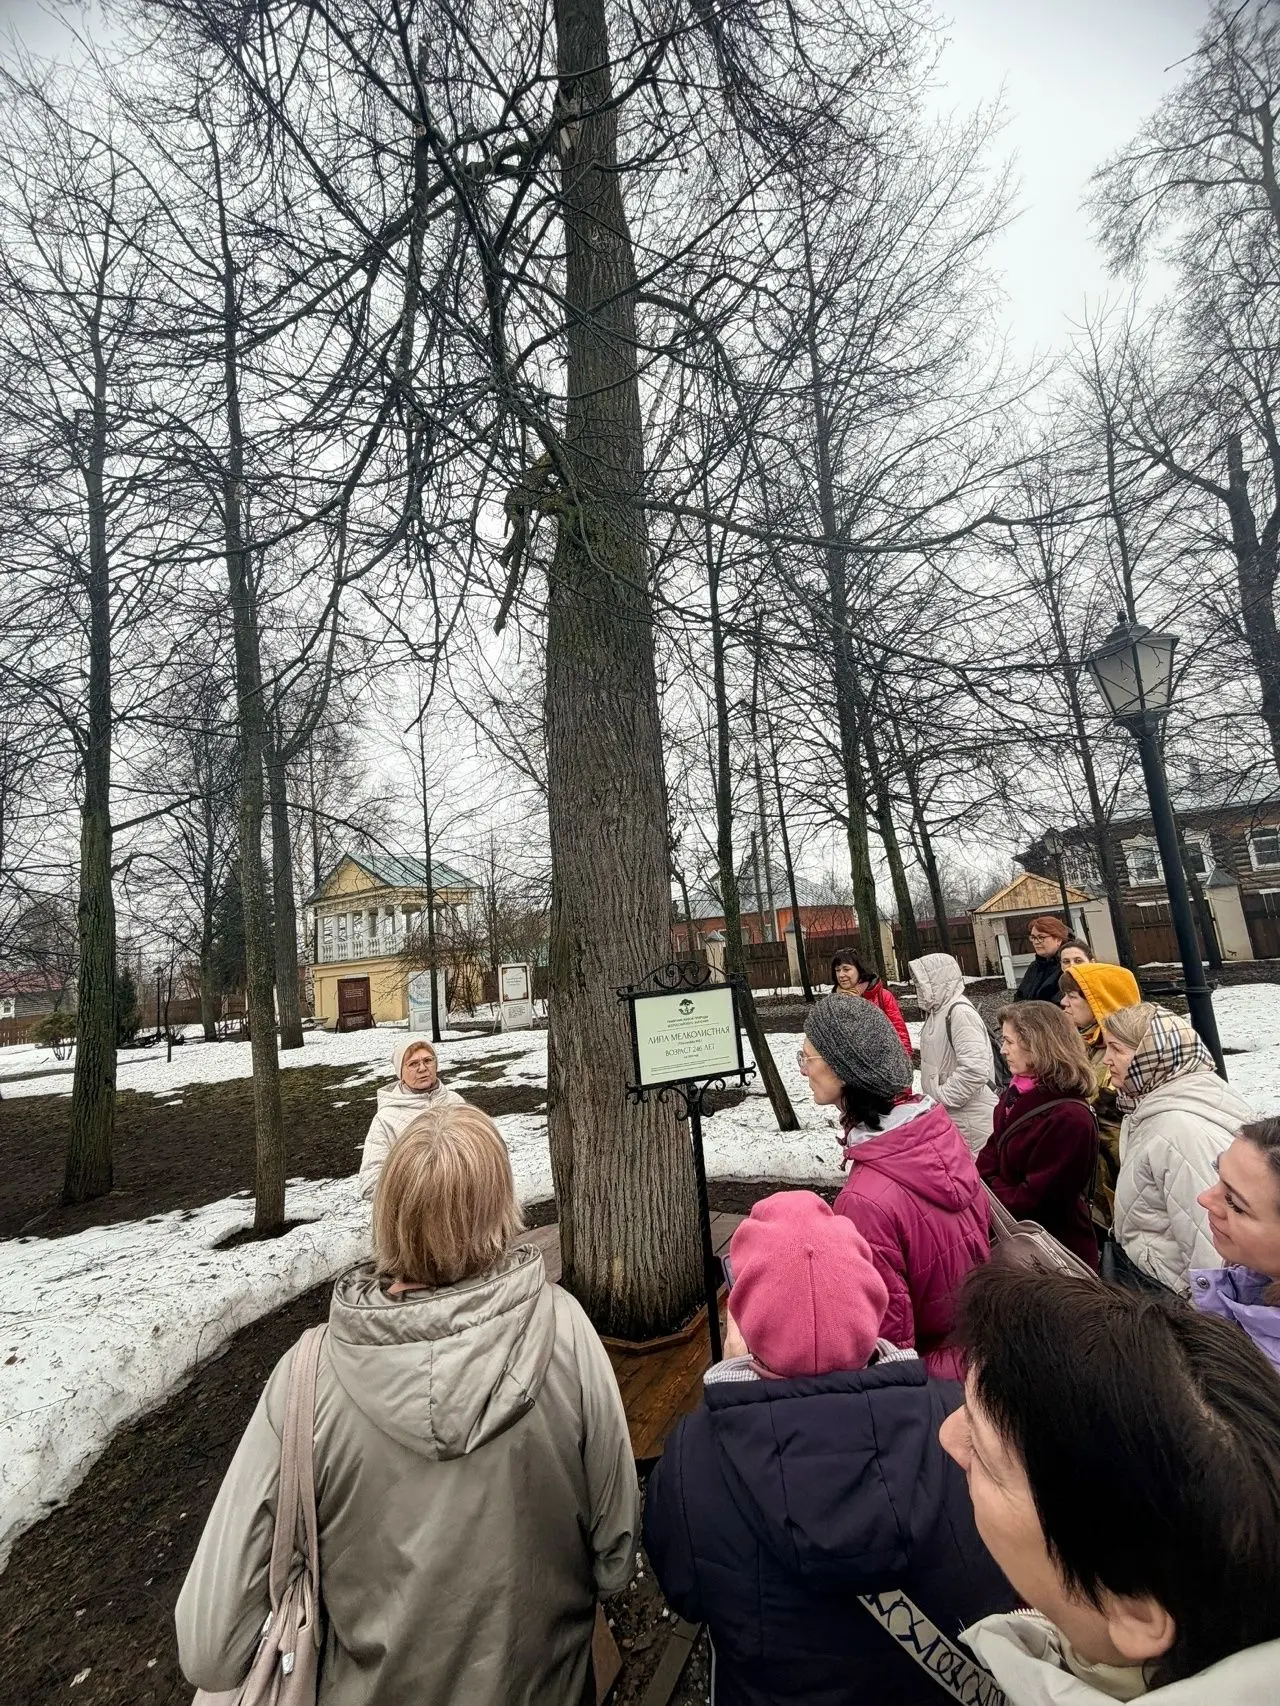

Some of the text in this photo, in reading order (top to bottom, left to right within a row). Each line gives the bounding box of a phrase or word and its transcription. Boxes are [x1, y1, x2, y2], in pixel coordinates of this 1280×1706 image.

[648, 1026, 730, 1045] ЛИПА МЕЛКОЛИСТНАЯ
[665, 1046, 691, 1056] ВОЗРАСТ
[704, 1043, 715, 1051] ЛЕТ
